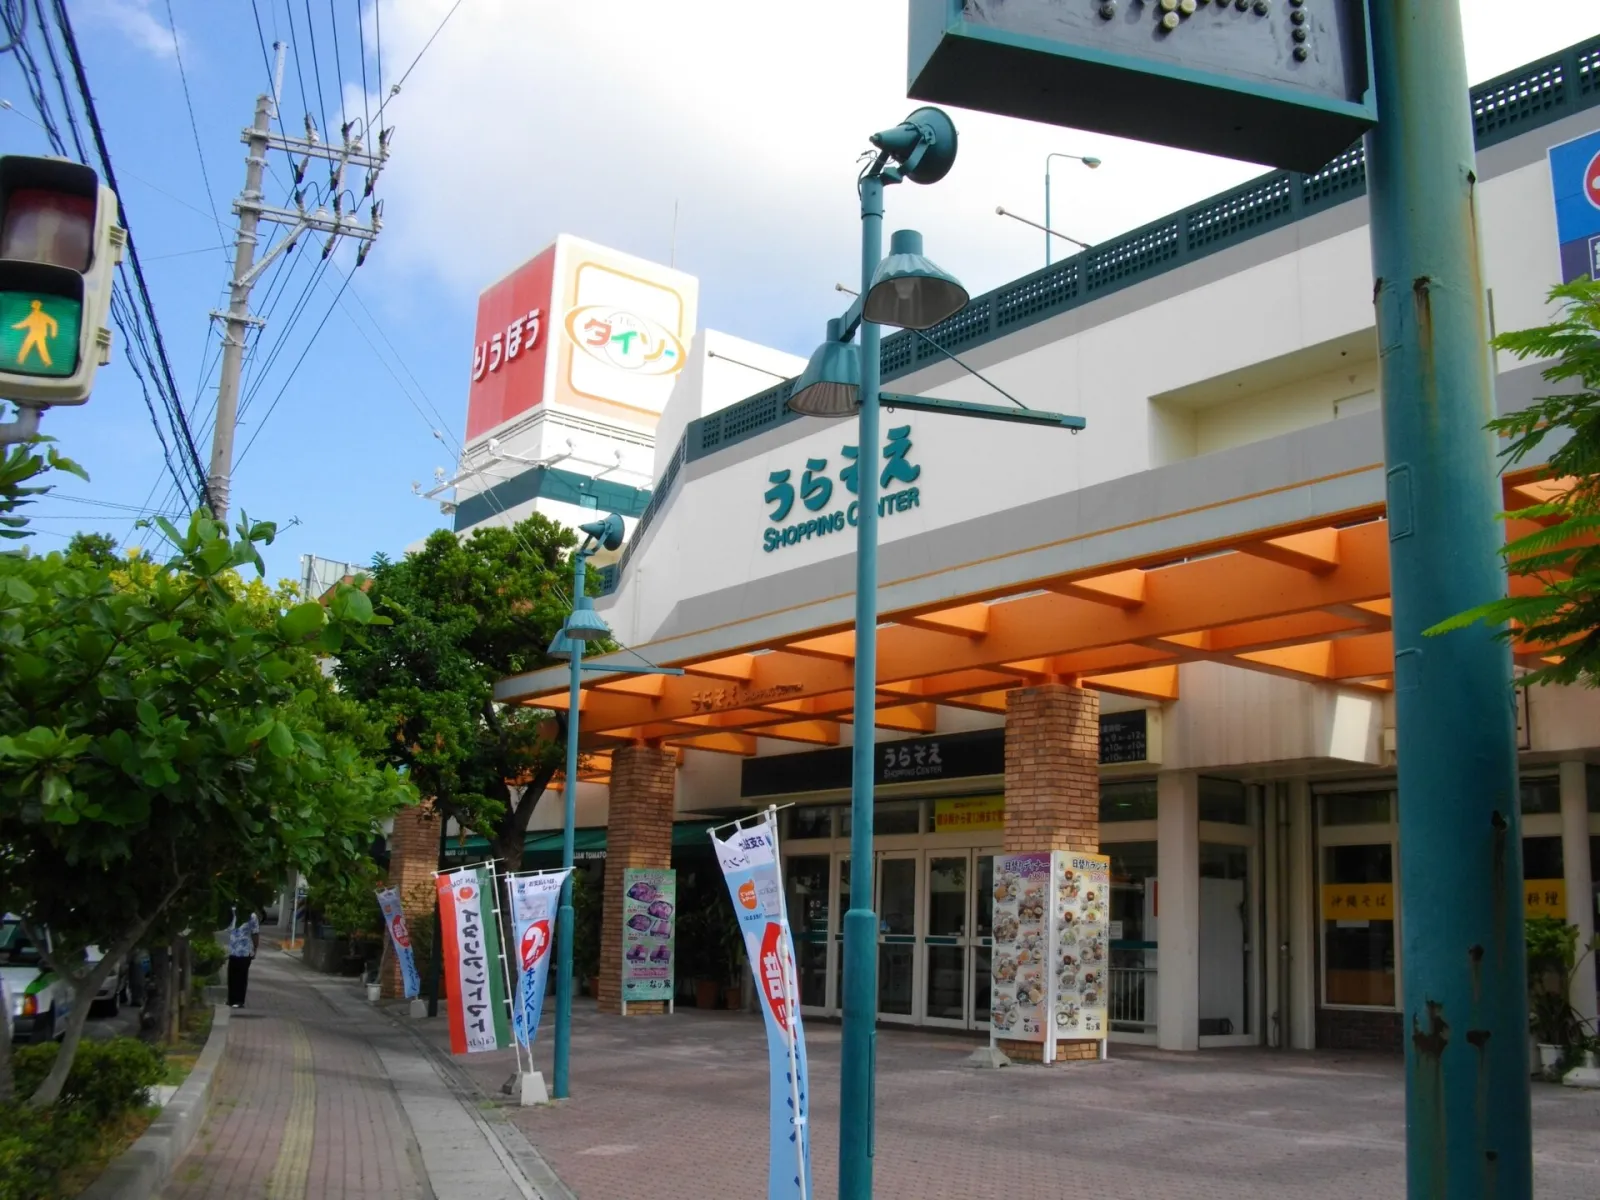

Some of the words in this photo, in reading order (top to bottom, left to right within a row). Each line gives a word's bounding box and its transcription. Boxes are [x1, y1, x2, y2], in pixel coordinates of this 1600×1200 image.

[473, 308, 541, 382] りうぼう
[583, 317, 675, 362] ダイソー
[763, 511, 845, 553] SHOPPING
[847, 487, 920, 527] CNTER
[884, 743, 942, 768] うらそえ
